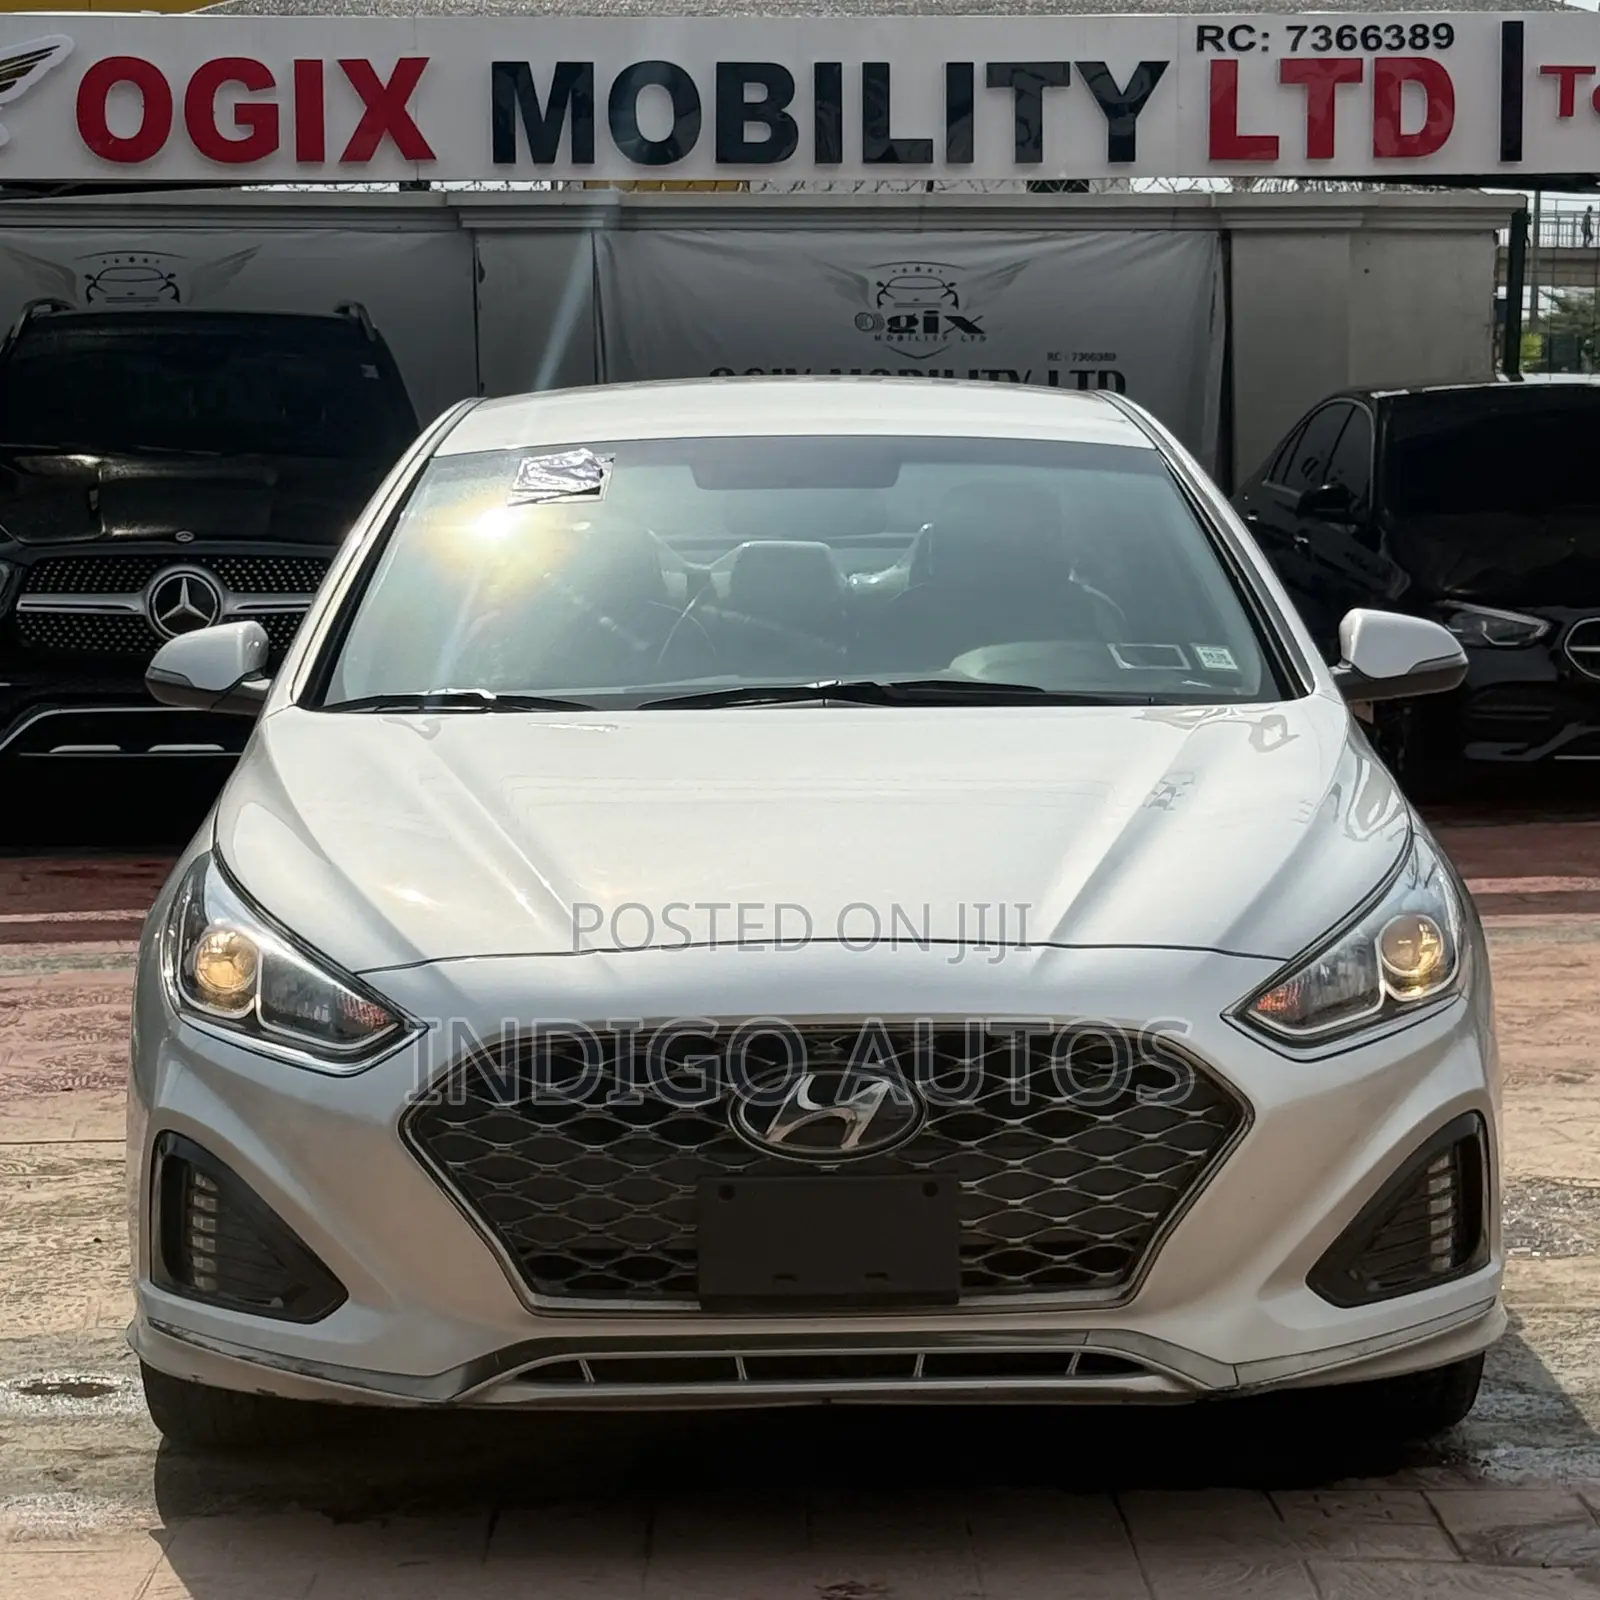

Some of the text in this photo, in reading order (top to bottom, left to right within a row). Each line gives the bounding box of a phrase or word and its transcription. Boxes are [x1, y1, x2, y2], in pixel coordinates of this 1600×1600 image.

[1196, 23, 1455, 52] RC: 7366389
[76, 56, 1456, 165] OGIX MOBILITY LTD
[1540, 65, 1600, 117] T
